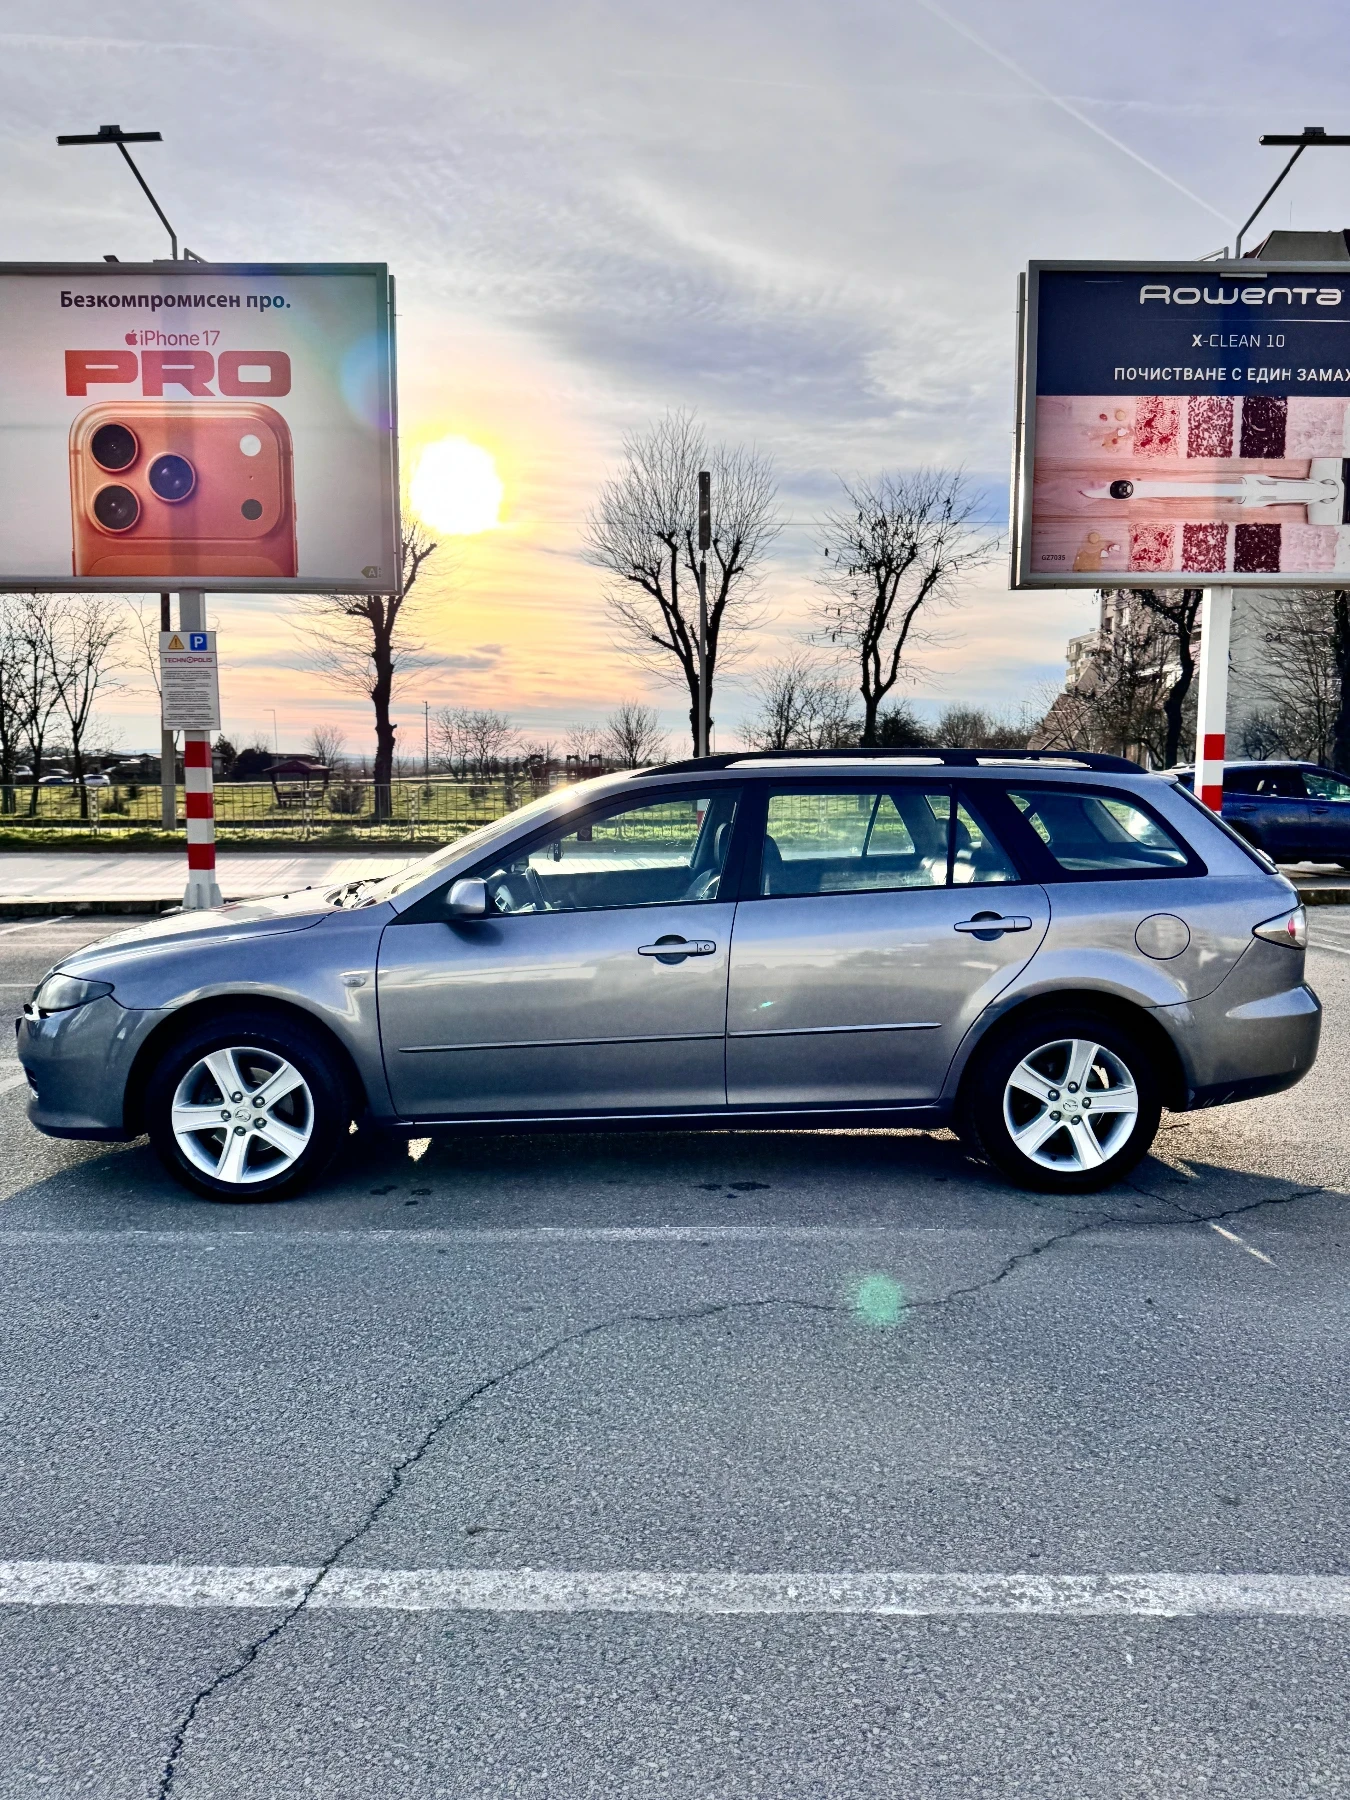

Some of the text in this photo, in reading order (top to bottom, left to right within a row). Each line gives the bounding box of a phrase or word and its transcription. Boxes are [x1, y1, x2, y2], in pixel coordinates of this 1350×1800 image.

[60, 290, 291, 312] Безкомпромисен про.
[139, 329, 221, 346] iPhone 17
[1191, 334, 1286, 348] X-CLEAN 10
[64, 350, 292, 397] PRO
[1114, 367, 1227, 381] ПОЧИСТВАНЕ
[1231, 367, 1242, 381] С
[1247, 368, 1292, 384] ЕДИН
[193, 636, 204, 648] P
[164, 656, 213, 664] TECHNOPOLIS
